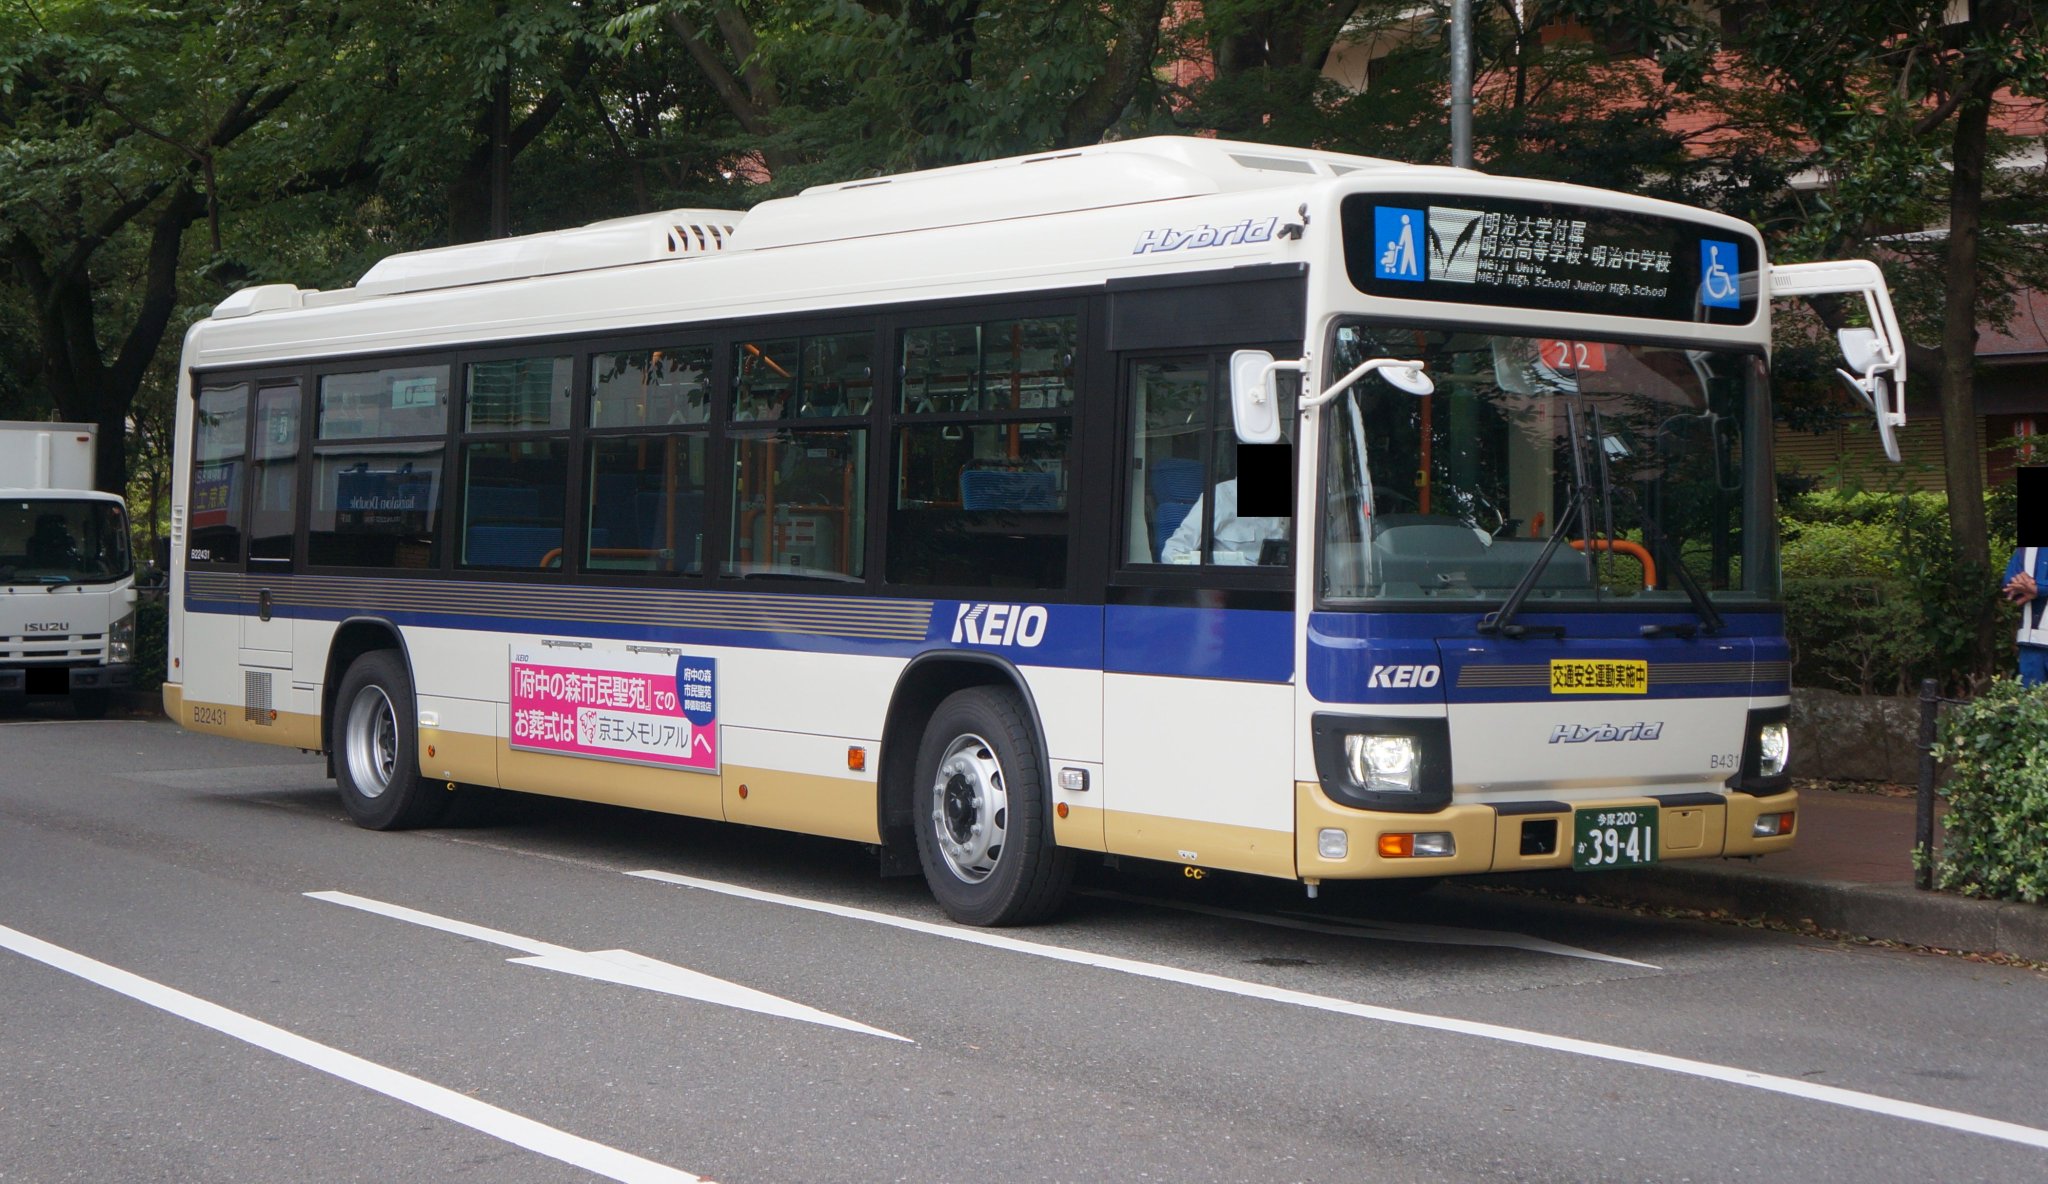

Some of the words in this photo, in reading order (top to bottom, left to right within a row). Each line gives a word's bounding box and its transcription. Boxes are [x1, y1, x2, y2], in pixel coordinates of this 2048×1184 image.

[1133, 217, 1278, 255] Hybrid
[1484, 212, 1587, 243] 明治大学付属
[1479, 259, 1509, 273] Meiji
[1516, 261, 1546, 275] Univ.
[1476, 272, 1503, 286] Meiji
[1507, 274, 1530, 288] High
[1534, 276, 1571, 290] School
[1572, 279, 1607, 293] Junior
[1609, 282, 1631, 296] High
[1632, 285, 1668, 298] School
[1555, 341, 1591, 369] 22
[190, 548, 210, 560] B22431
[24, 622, 69, 632] ISUZU
[951, 602, 1048, 648] KEIO
[683, 668, 712, 683] 府中の森
[1367, 664, 1441, 688] KEIO
[1553, 663, 1645, 689] 交通安全運動実施中
[683, 684, 712, 699] 市民聖苑
[194, 705, 227, 726] B22431
[515, 709, 575, 742] お葬式は
[599, 717, 689, 748] 京王メモリアル
[1549, 722, 1664, 744] Hybrid
[1710, 754, 1740, 770] B431
[1588, 826, 1652, 865] 39-41
